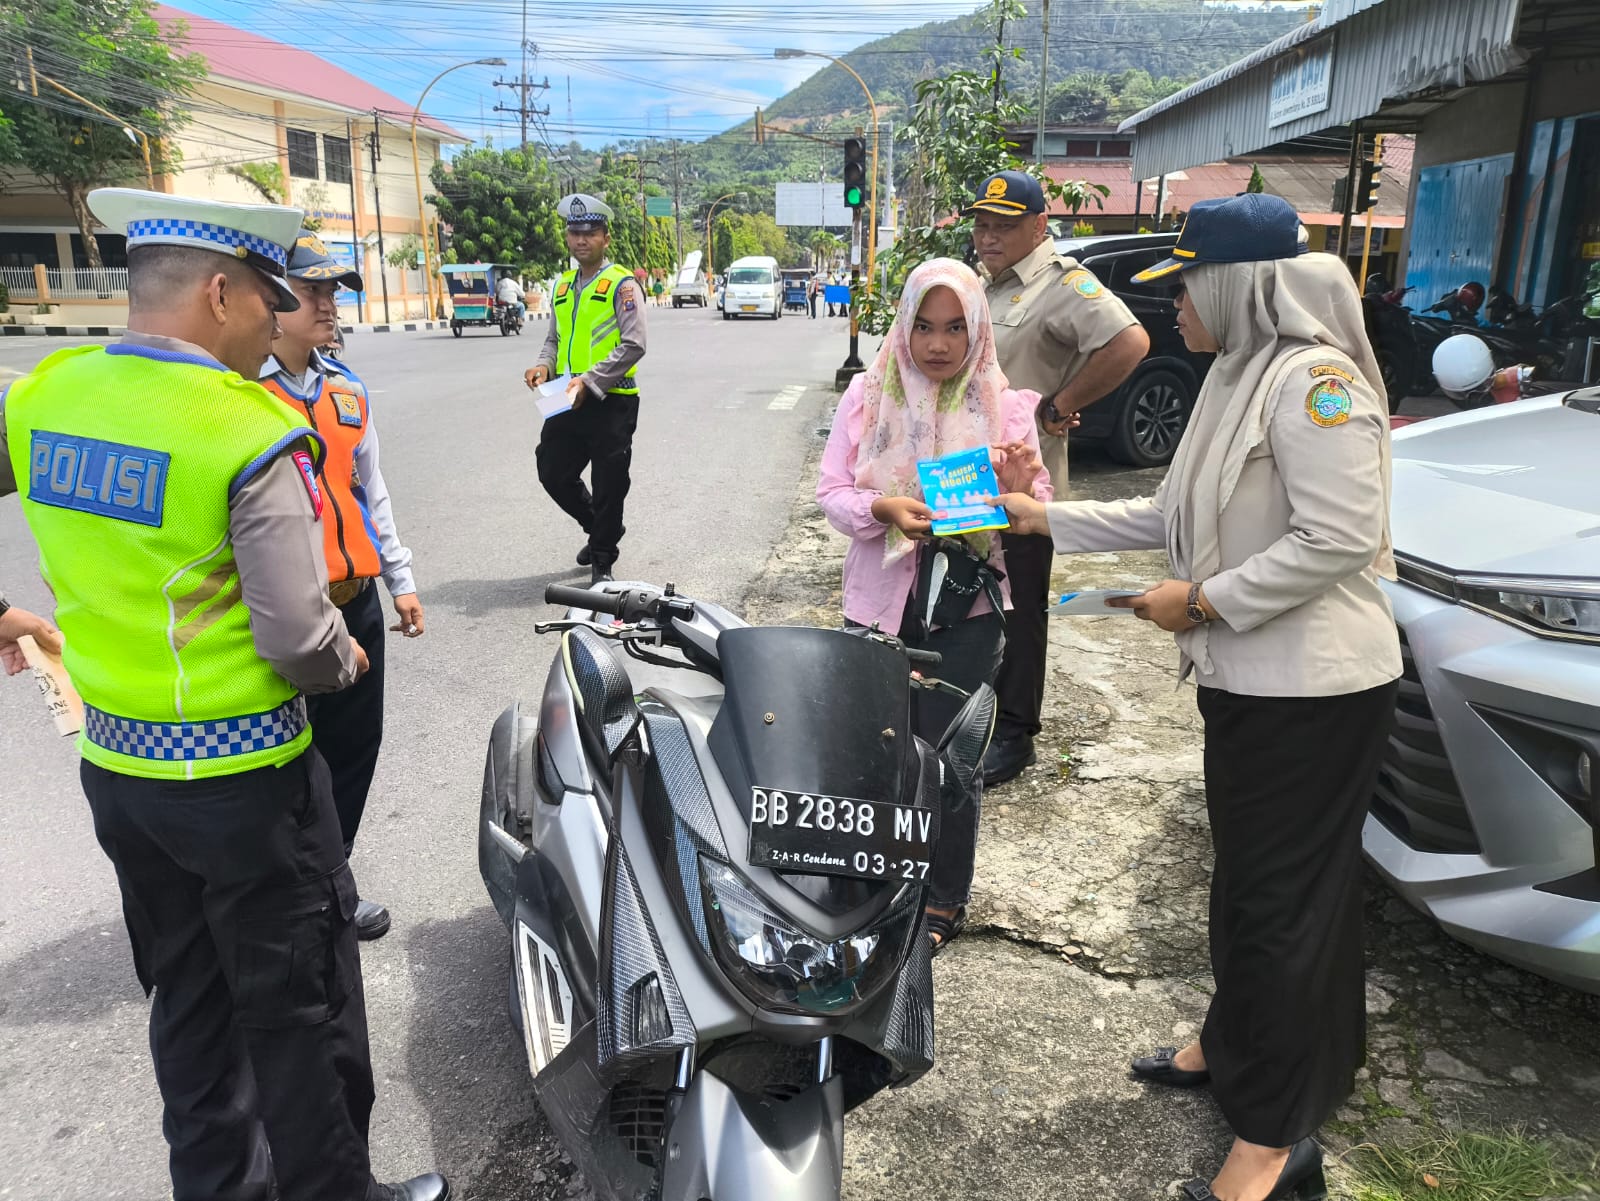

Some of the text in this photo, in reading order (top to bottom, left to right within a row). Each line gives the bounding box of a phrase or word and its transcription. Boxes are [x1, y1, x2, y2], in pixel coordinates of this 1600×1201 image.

[32, 439, 162, 512] POLISI
[752, 789, 932, 843] BB 2838 MV
